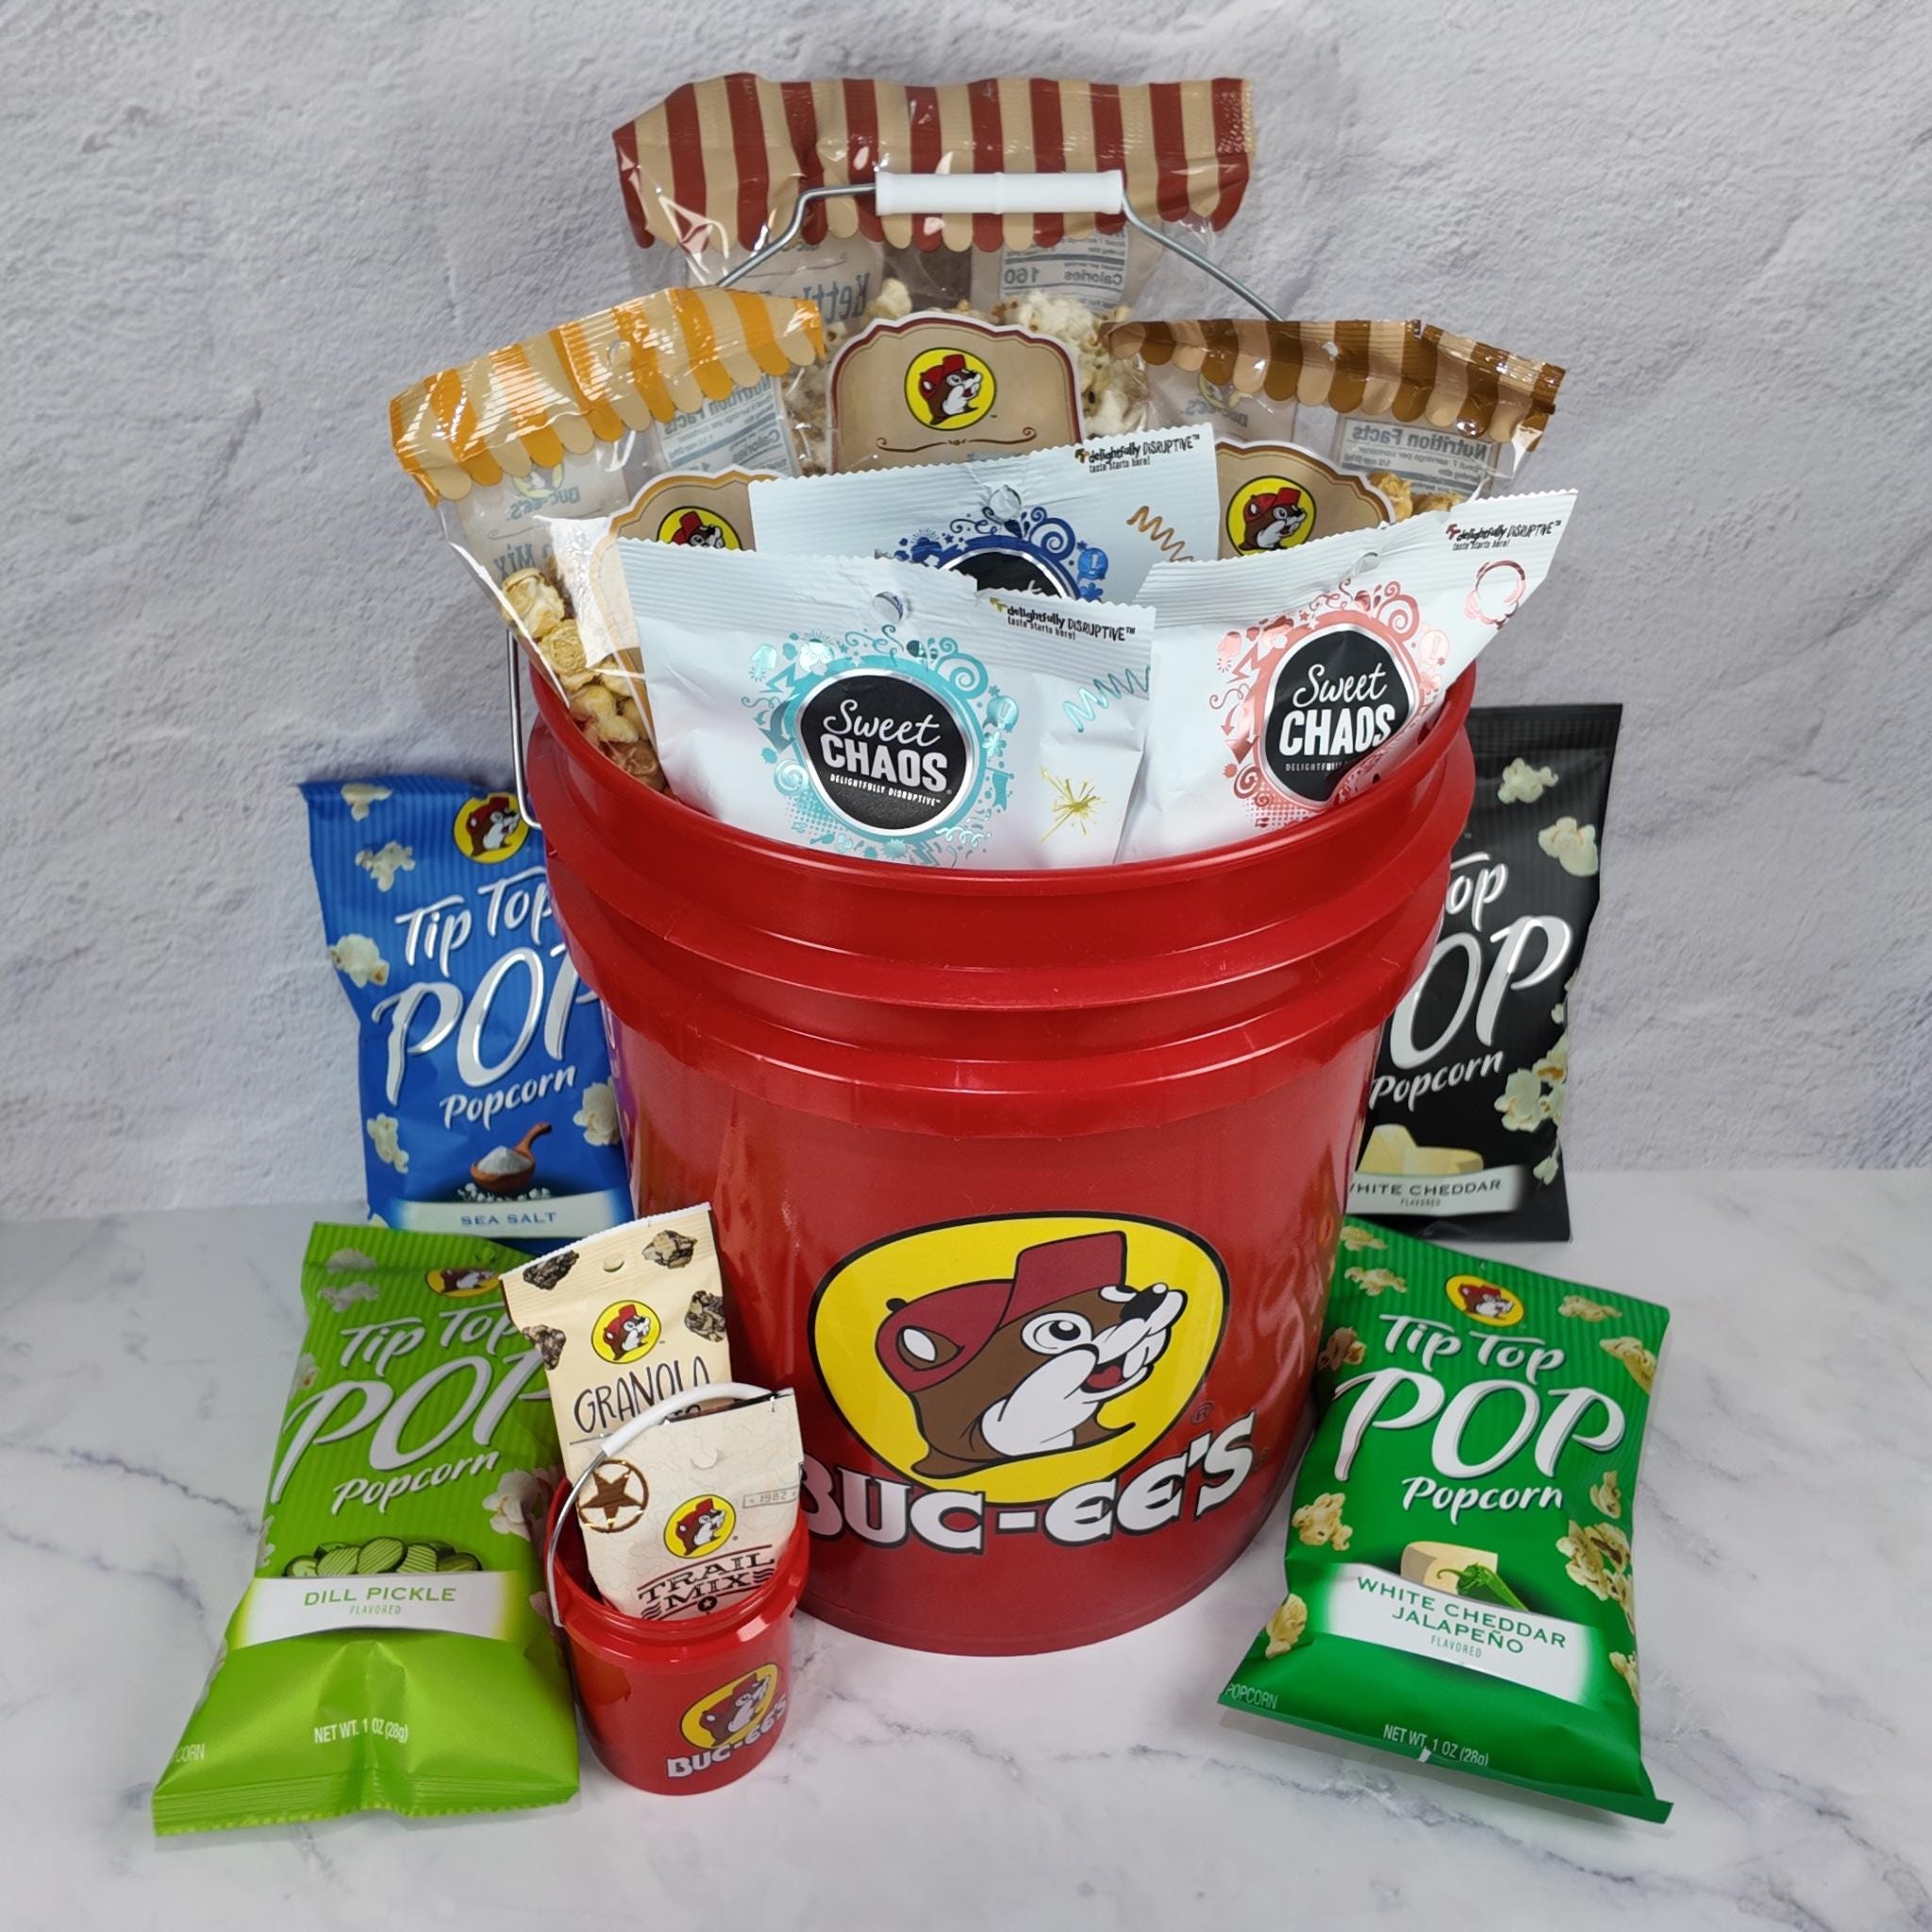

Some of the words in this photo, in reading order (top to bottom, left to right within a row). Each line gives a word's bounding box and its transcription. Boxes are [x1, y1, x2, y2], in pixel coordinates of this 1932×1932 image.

[1007, 606, 1066, 629] delightfully
[1008, 616, 1027, 628] taste
[1030, 622, 1053, 635] starts
[1292, 662, 1389, 708] Sweet
[823, 699, 941, 747] Sweet
[1278, 703, 1396, 757] CHAOS
[820, 733, 949, 792] CHAOS
[830, 773, 887, 794] DELIGHTFULLY
[394, 893, 472, 977] Tip
[1390, 915, 1573, 1071] OP
[439, 1064, 576, 1131] Popcorn
[1368, 1050, 1505, 1113] Popcorn
[1349, 1181, 1403, 1196] HITE
[1408, 1178, 1503, 1197] CHEDDAR
[1400, 1198, 1442, 1208] FLAVORED
[460, 1215, 500, 1226] SEA
[507, 1210, 558, 1224] SALT
[340, 1316, 426, 1377] Tip
[1378, 1313, 1461, 1373] Tip
[1469, 1329, 1565, 1386] Top
[1332, 1367, 1626, 1482] POP
[331, 1450, 500, 1515] Popcorn
[759, 1491, 788, 1503] 1982
[1401, 1475, 1563, 1525] Popcorn
[304, 1588, 358, 1606] DILL
[366, 1587, 458, 1602] PICKLE
[639, 1553, 774, 1605] TRAIL
[663, 1572, 754, 1611] MIX
[349, 1604, 403, 1616] FLAVORED
[1357, 1576, 1436, 1611] WHITE
[1444, 1603, 1567, 1649] CHEDDAR
[1391, 1607, 1524, 1654] JALAPEÑO
[1430, 1634, 1482, 1658] FLAVORED
[1224, 1683, 1279, 1710] POPCORN
[313, 1724, 337, 1744] NET
[361, 1717, 369, 1734] 1
[371, 1717, 385, 1736] OZ
[385, 1720, 408, 1744] (28g)
[1383, 1724, 1407, 1743] NET
[1432, 1738, 1440, 1753] 1
[1441, 1740, 1458, 1758] OZ
